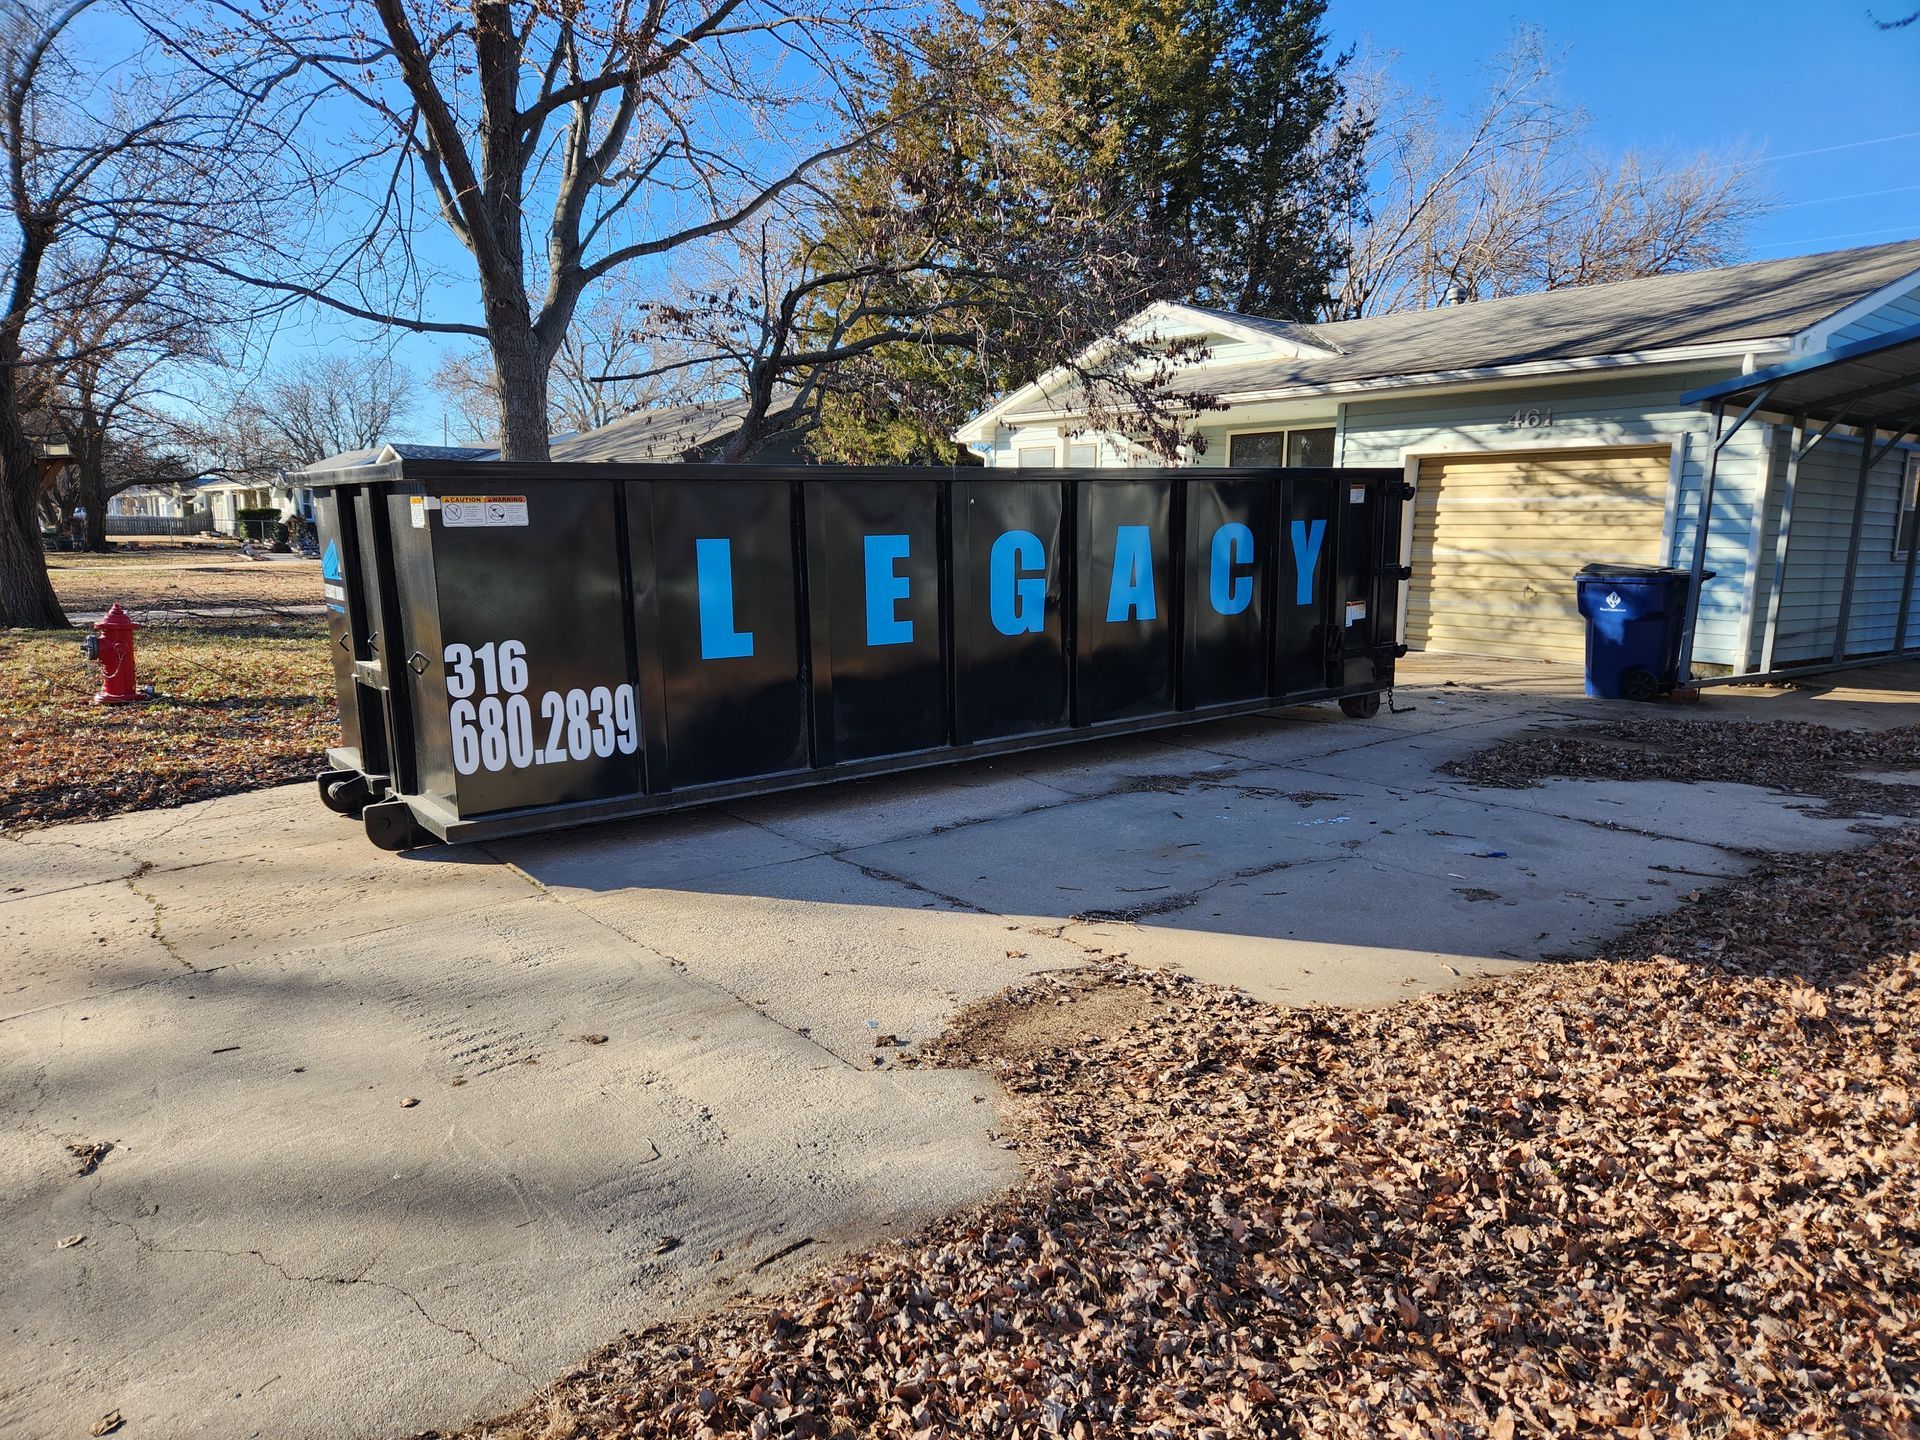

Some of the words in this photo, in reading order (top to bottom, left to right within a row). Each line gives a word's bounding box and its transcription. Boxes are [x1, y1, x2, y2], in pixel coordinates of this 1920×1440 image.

[1506, 407, 1553, 429] 461
[695, 519, 1327, 660] LEGACY
[443, 639, 529, 698] 316
[450, 683, 639, 776] 680.2839
